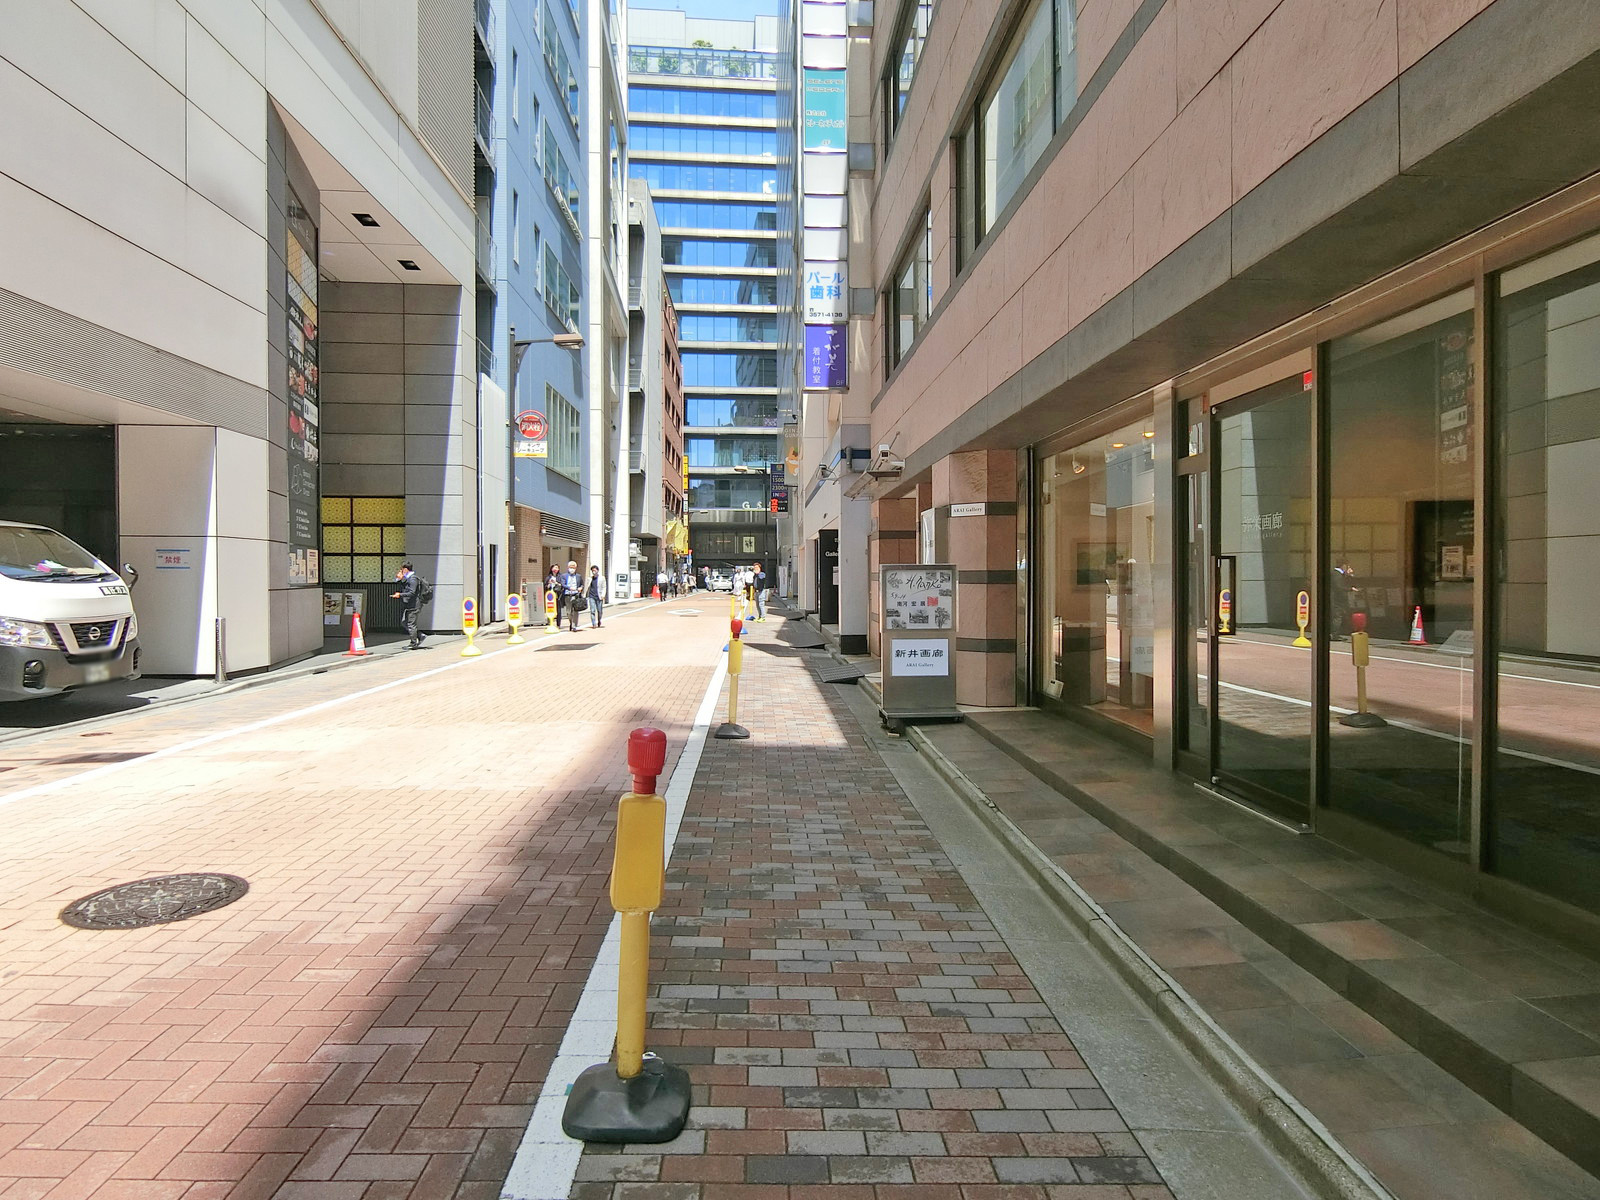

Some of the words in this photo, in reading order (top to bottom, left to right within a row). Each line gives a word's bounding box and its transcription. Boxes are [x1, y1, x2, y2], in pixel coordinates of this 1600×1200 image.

[807, 271, 845, 283] パール
[810, 285, 841, 300] 歯科
[812, 347, 821, 384] 着付教室
[522, 422, 541, 431] 消火栓
[165, 556, 181, 564] 禁煙
[895, 649, 944, 658] 新井画廊
